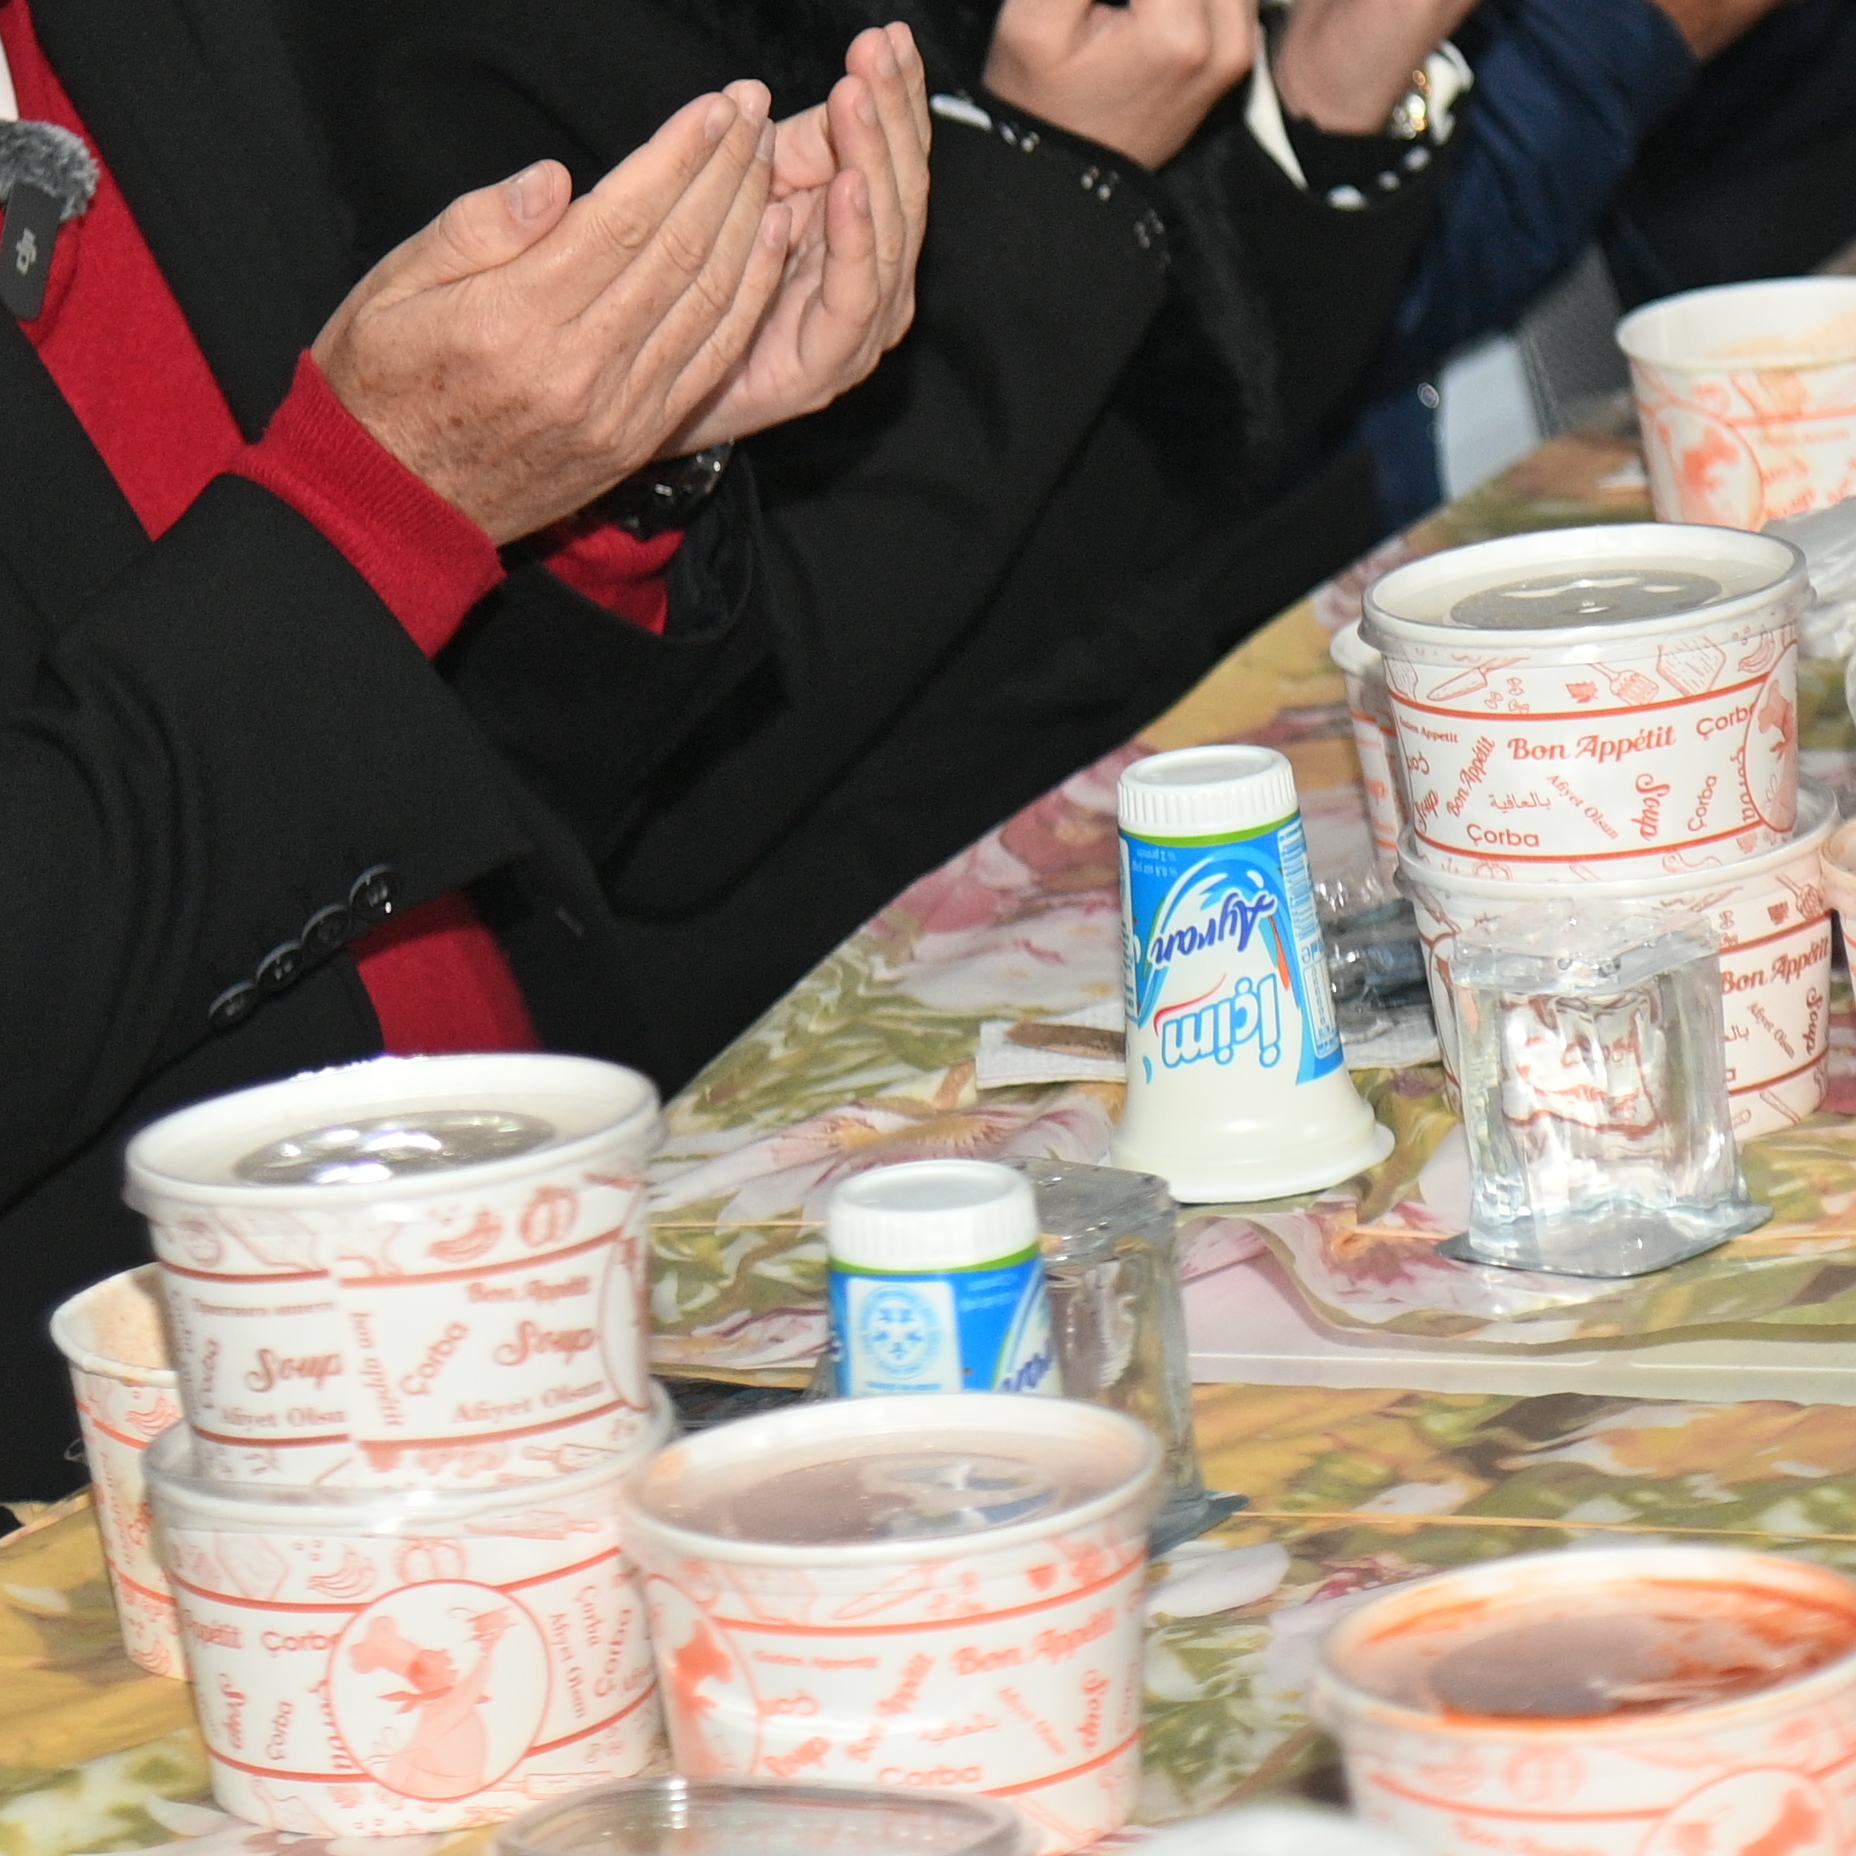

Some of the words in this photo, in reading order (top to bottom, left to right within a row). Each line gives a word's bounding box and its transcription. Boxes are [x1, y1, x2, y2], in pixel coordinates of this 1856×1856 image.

[1507, 737, 1571, 761] Bon
[1574, 725, 1677, 764] Appétit
[1446, 785, 1472, 819] Bon
[1583, 804, 1620, 841] Olsun
[1630, 772, 1672, 842] Soup
[1687, 774, 1719, 833] Çorba
[1466, 822, 1541, 849] Çorba
[1150, 891, 1277, 965] Ayran
[1159, 971, 1283, 1070] İçim
[400, 1321, 472, 1396] Çorba
